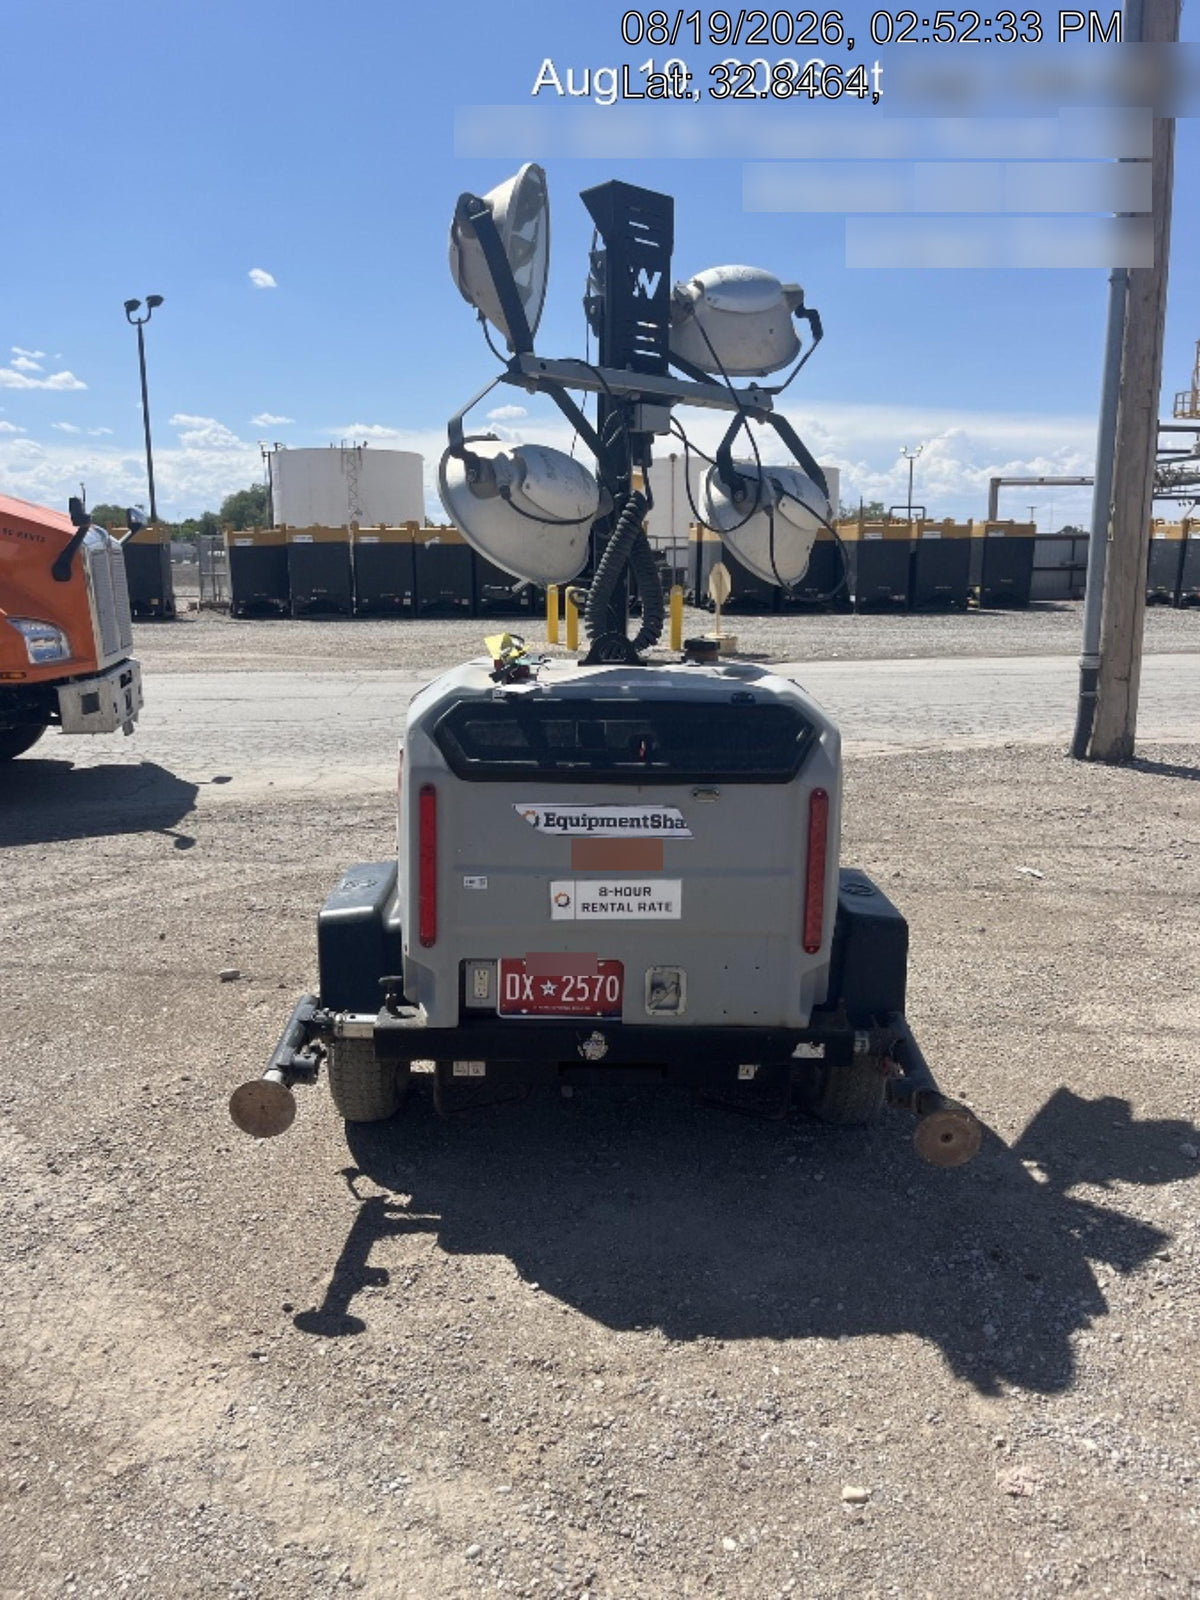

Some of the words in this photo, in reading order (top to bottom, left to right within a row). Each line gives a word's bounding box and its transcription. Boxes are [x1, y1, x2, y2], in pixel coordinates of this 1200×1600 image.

[543, 811, 689, 831] EquipmentSha
[598, 886, 652, 897] 8-HOUR
[581, 901, 633, 913] RENTAL
[638, 901, 673, 913] RATE
[505, 973, 535, 1001] DX
[561, 975, 620, 1002] 2570
